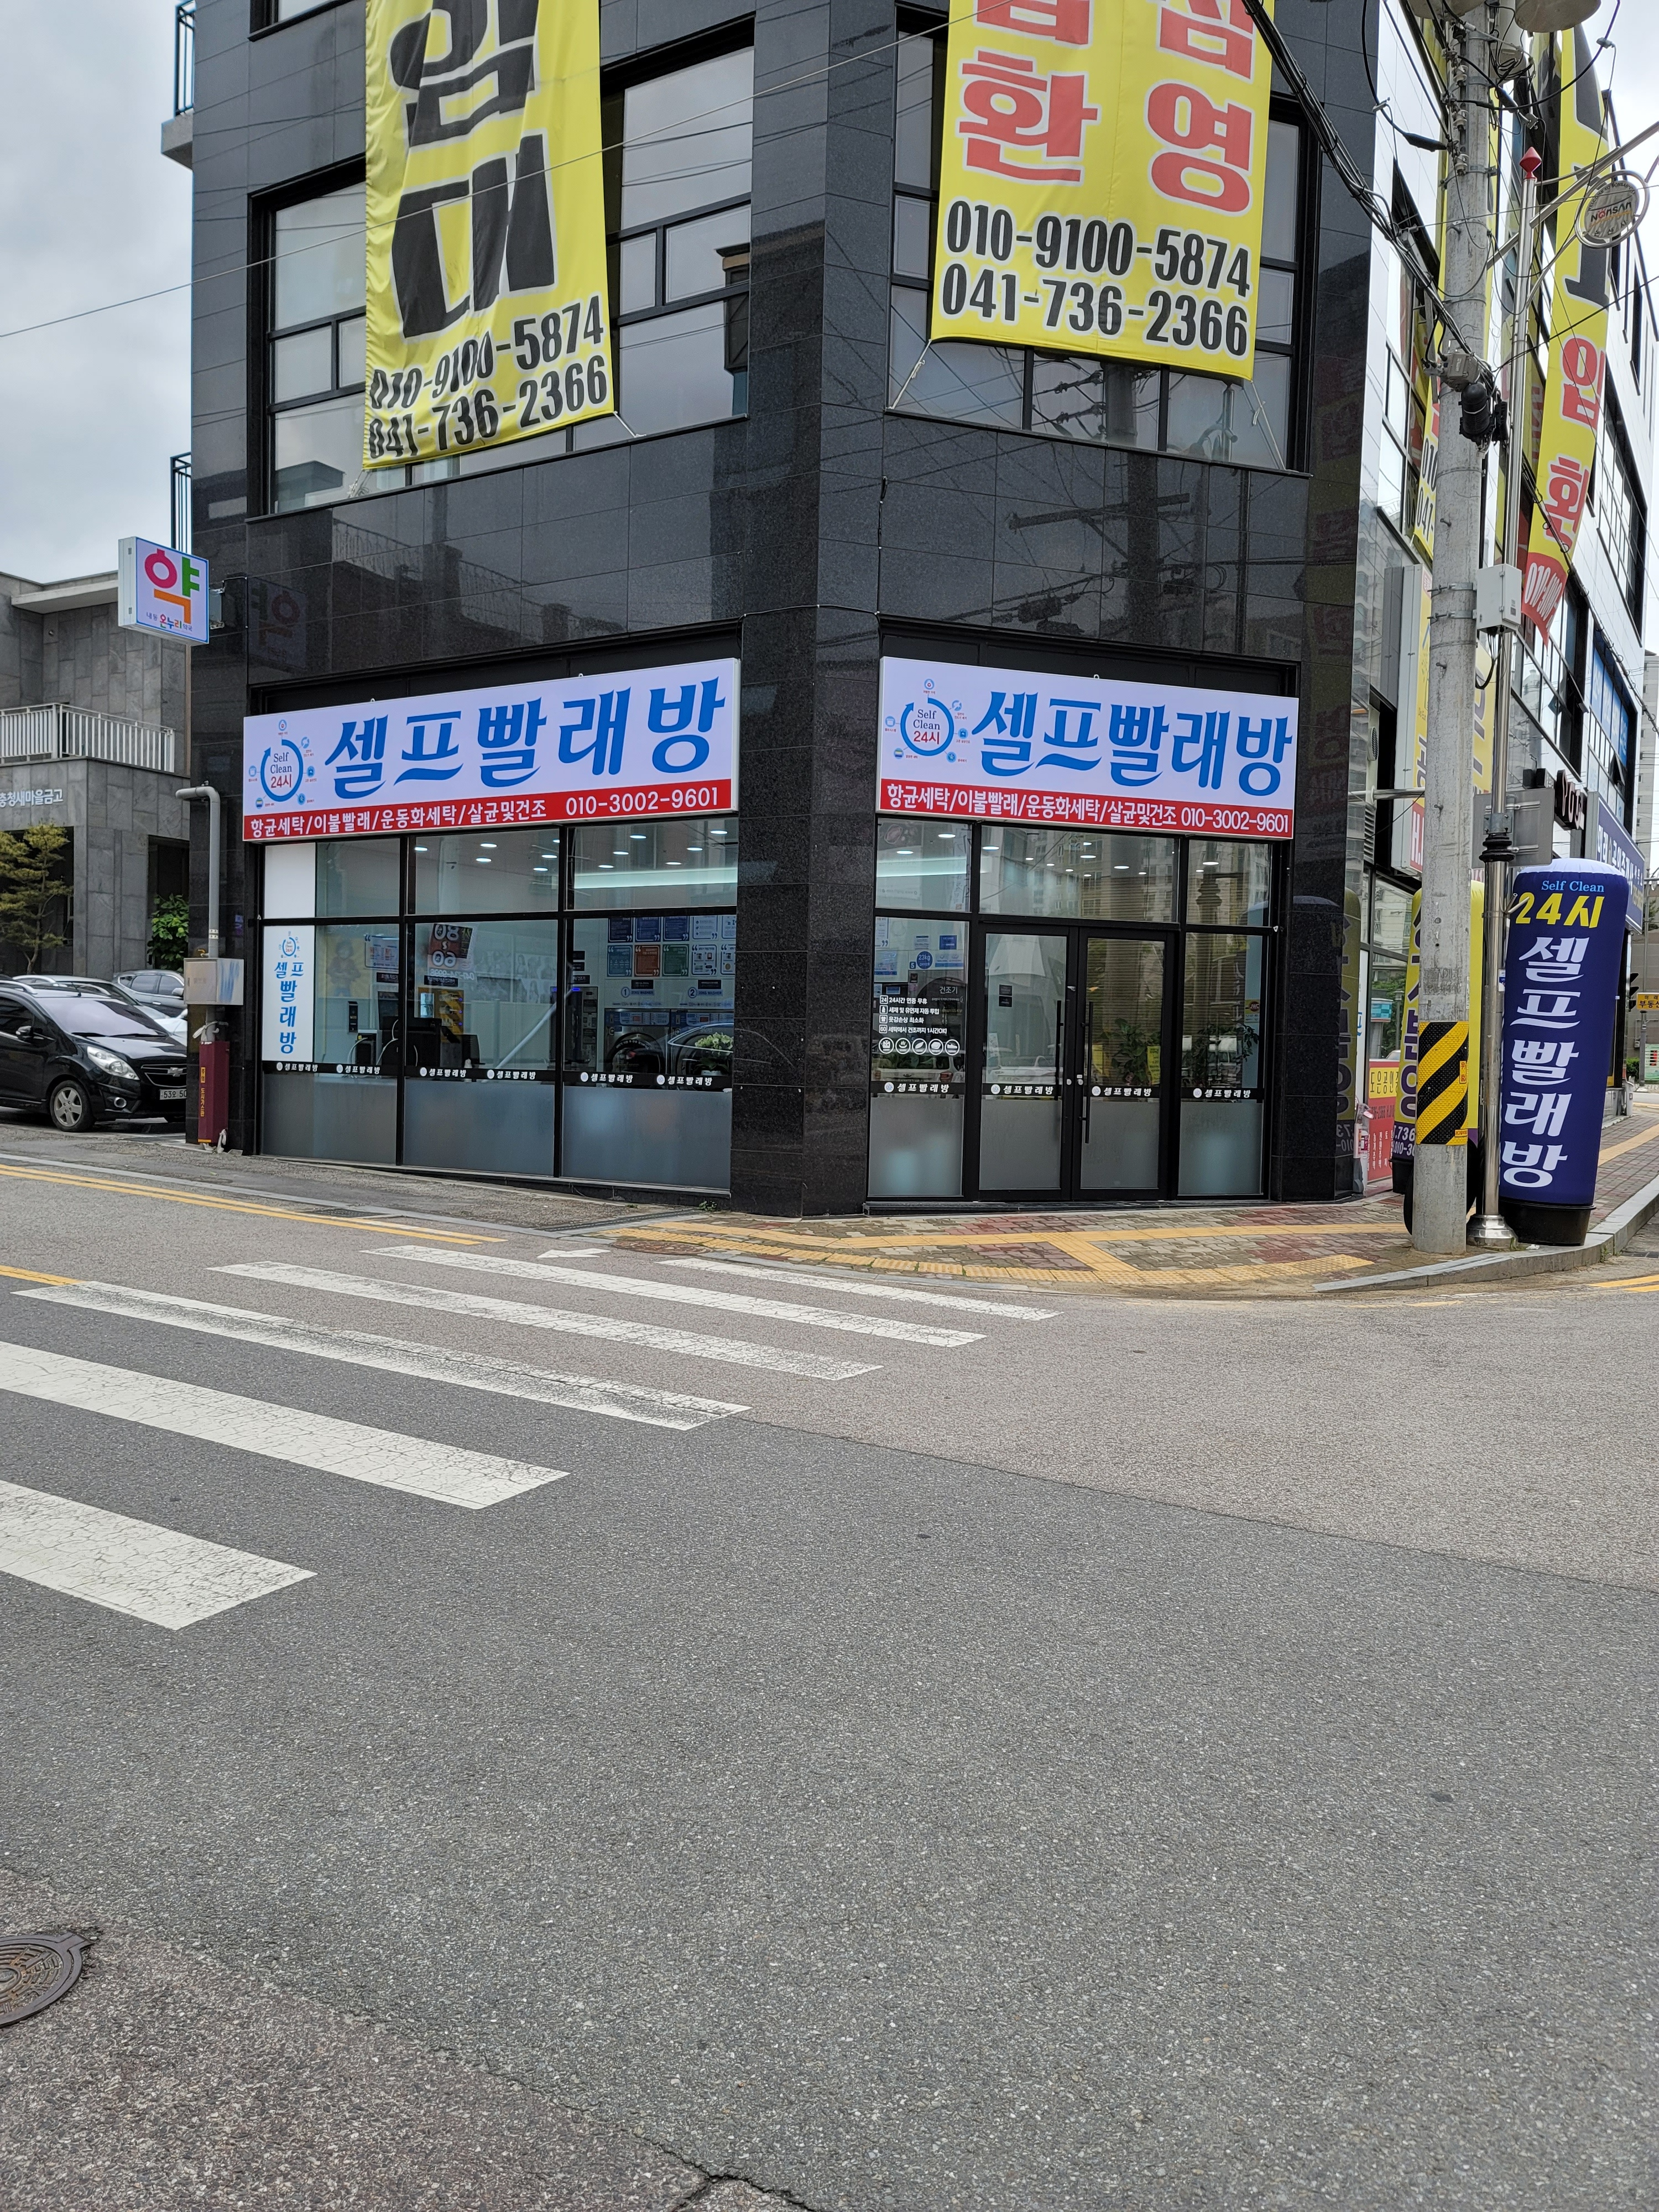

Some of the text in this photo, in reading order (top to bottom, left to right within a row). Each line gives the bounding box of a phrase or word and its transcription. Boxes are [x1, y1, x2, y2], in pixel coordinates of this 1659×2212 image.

[946, 200, 1250, 298] 010-9100-5874
[942, 263, 1248, 357] 041-736-2366
[369, 295, 604, 410] 010-9100-5874
[367, 356, 608, 460] 041-736-2366
[1417, 487, 1434, 542] 041-
[144, 547, 200, 625] 약
[159, 614, 182, 629] 온누리
[917, 709, 937, 719] Self
[913, 719, 940, 731] Clean
[325, 676, 726, 800] 셀프빨래방
[913, 731, 940, 744] 24시
[972, 691, 1293, 797] 셀프빨래방
[273, 752, 289, 763] Self
[270, 764, 292, 774] Clean
[270, 774, 292, 789] 24시
[250, 786, 718, 838] 항균세탁/이불빨래/운동화세탁/살균및건조 010-3002-9601
[887, 783, 1289, 833] 항균세탁/이불빨래/운동화세탁/살균및건조 010-3002-9601
[1541, 880, 1605, 893] Self Clean
[1515, 891, 1605, 928] 24시
[274, 962, 305, 979] 셀프
[940, 986, 958, 994] 건조기
[279, 980, 299, 1054] 빨래방
[1501, 936, 1590, 1188] 셀프빨래방
[667, 1076, 713, 1086] 셀프빨래방
[897, 1083, 950, 1093] 셀프빨래방
[163, 1091, 176, 1099] 53오
[1003, 1084, 1054, 1095] 셀프빨래방
[1103, 1086, 1152, 1097] 셀프빨래방
[1204, 1088, 1251, 1099] 셀프빨래방
